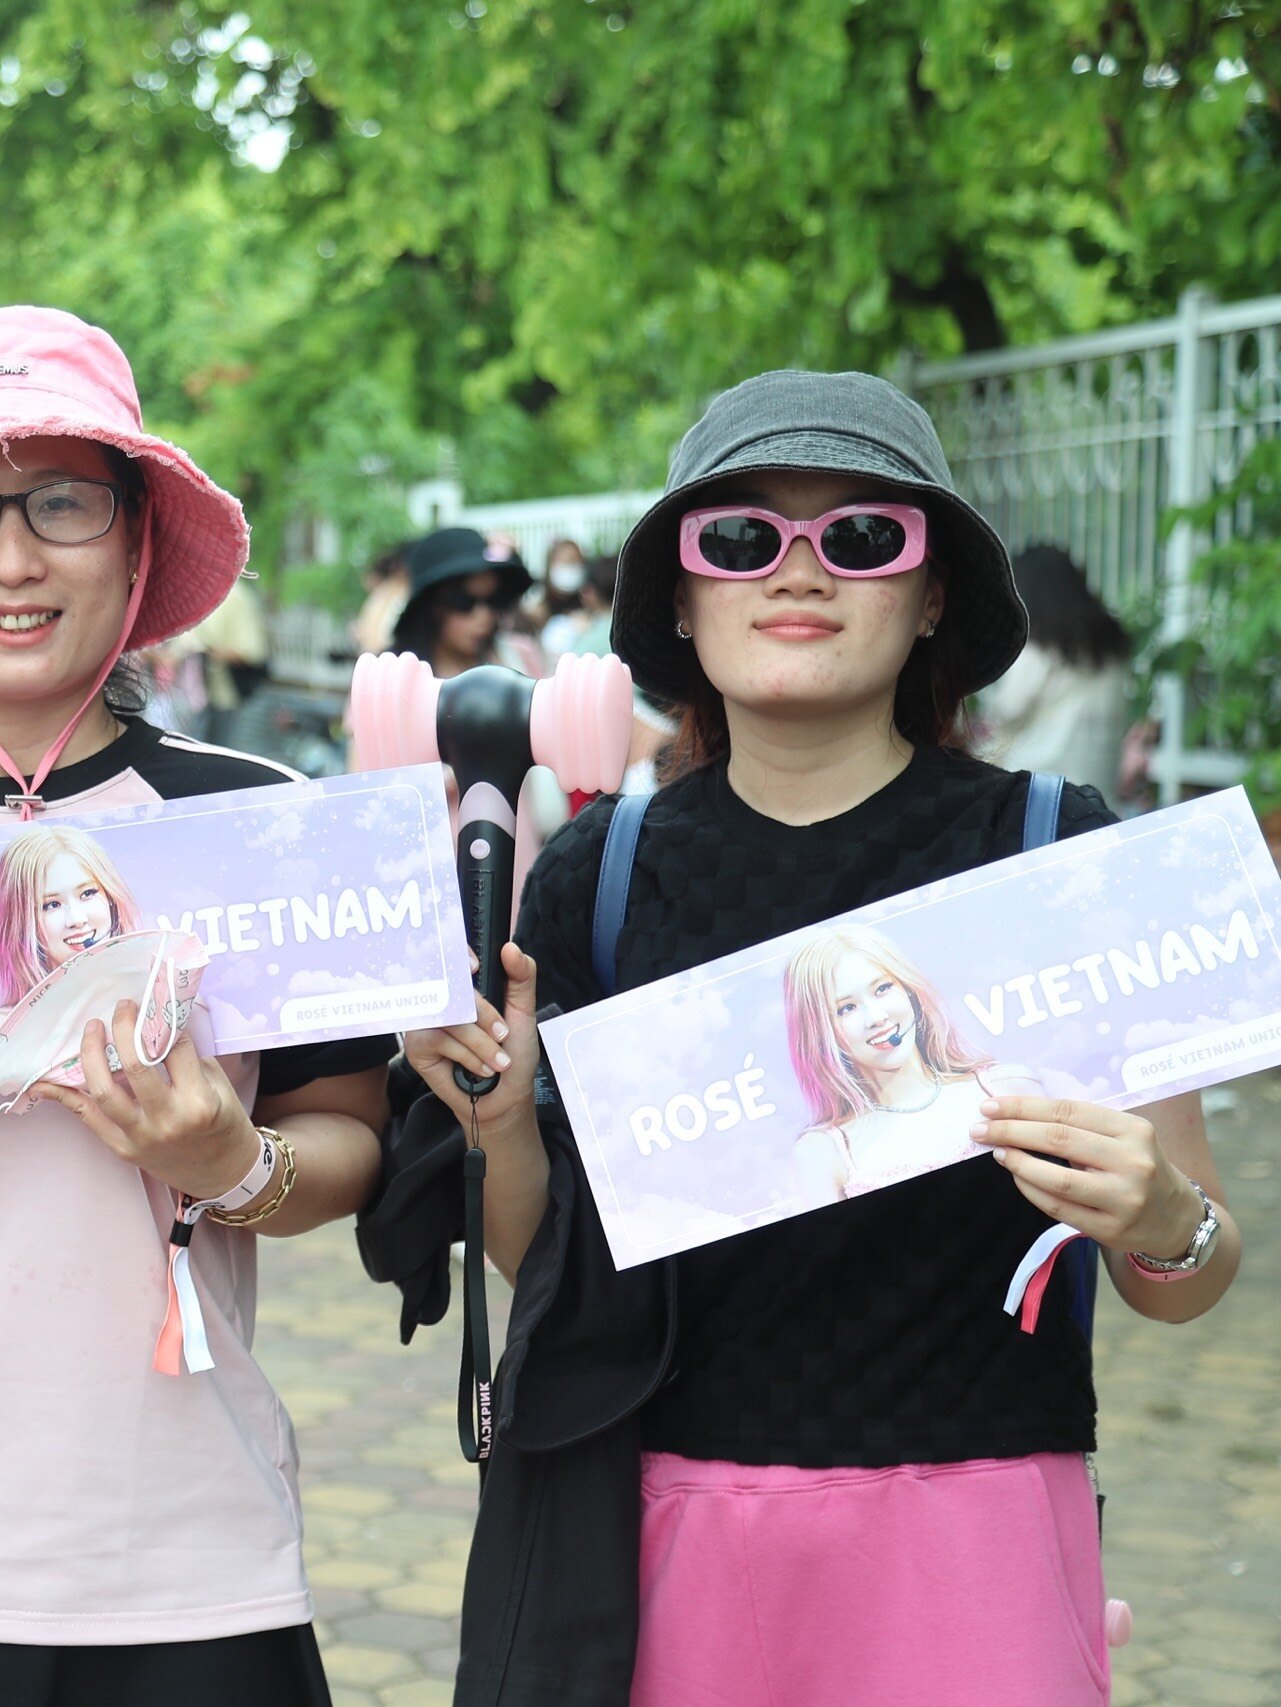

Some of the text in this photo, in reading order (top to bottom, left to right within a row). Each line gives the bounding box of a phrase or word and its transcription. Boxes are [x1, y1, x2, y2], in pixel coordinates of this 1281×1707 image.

[297, 993, 438, 1021] ROSÉ VIETNAM UNION
[628, 910, 1261, 1157] ROSÉ VIETNAM
[1140, 1054, 1176, 1078] ROSÉ
[1180, 1038, 1245, 1065] VIETNAM
